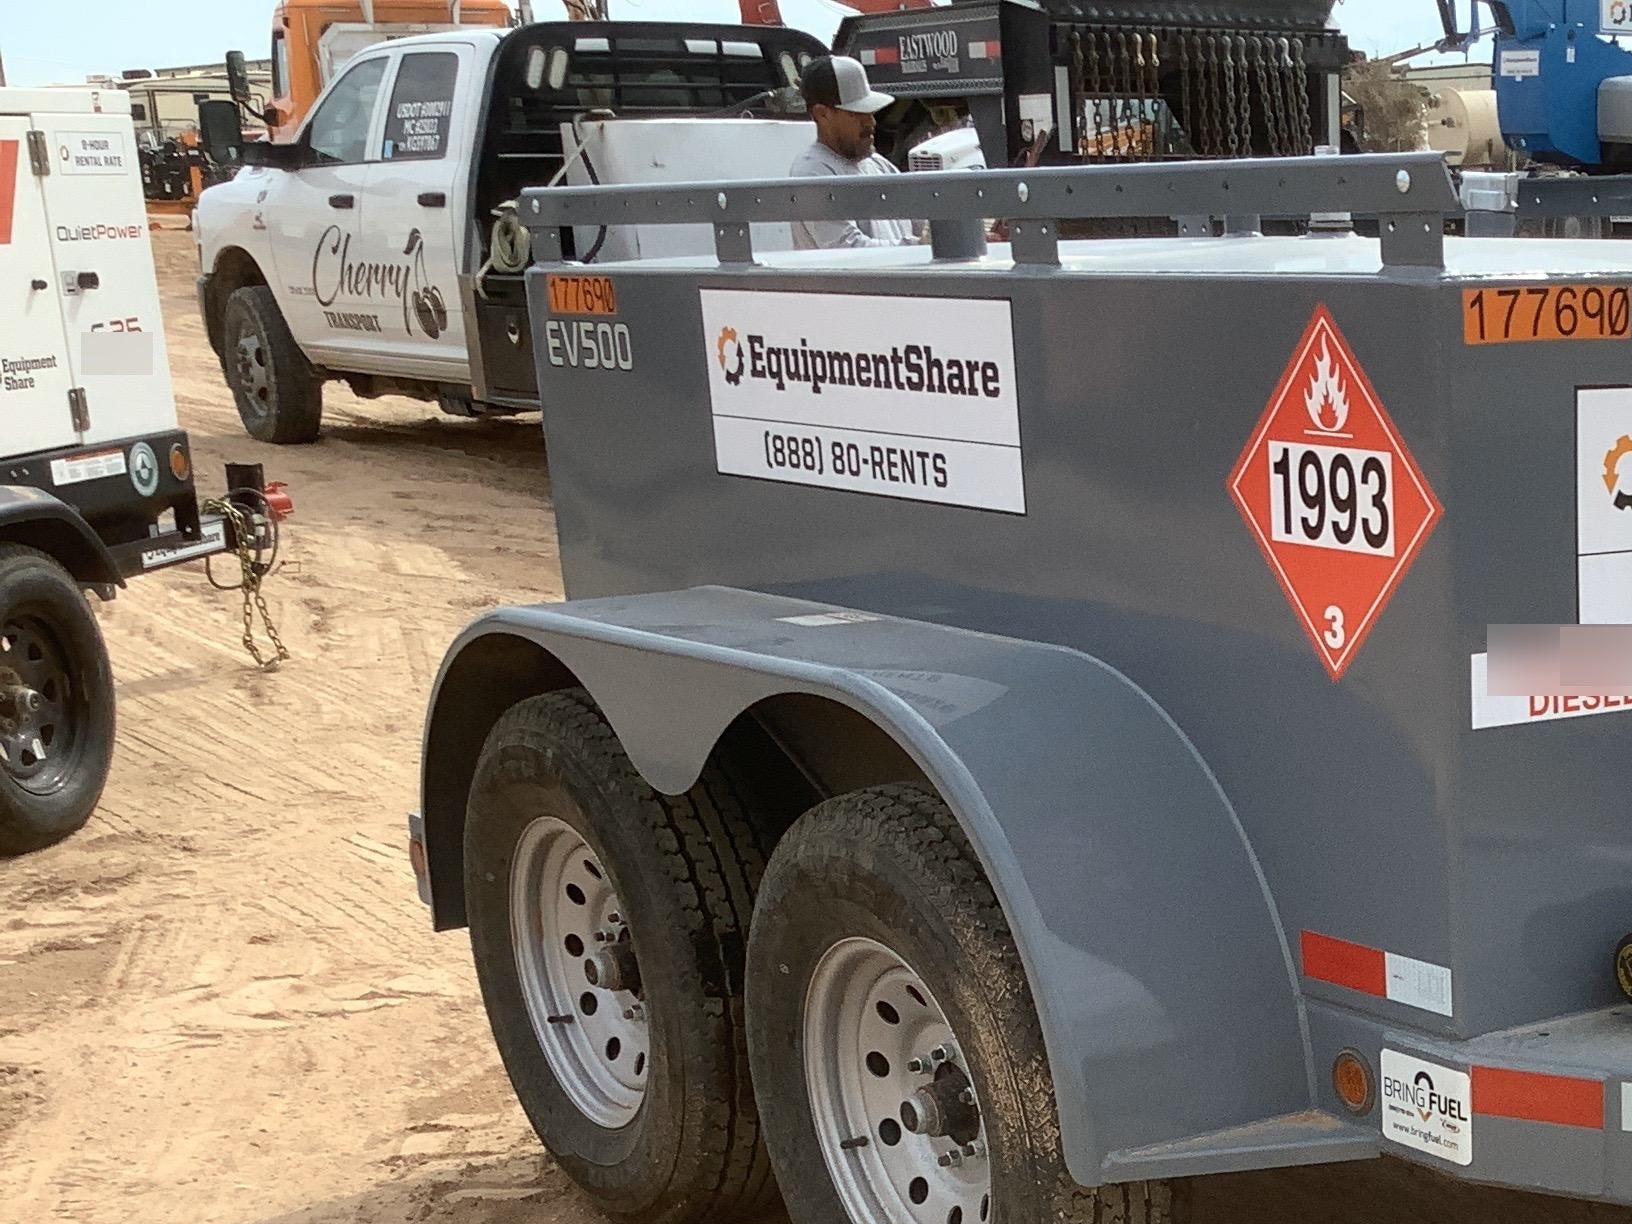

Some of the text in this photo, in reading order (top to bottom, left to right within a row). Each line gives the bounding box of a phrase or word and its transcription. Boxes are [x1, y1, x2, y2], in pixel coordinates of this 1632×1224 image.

[899, 30, 959, 60] EASTWOOD
[75, 156, 122, 167] RENTAL RATE
[81, 139, 110, 150] 8-HOUR
[56, 224, 142, 242] QuietPower
[313, 224, 413, 337] Cherry
[550, 277, 615, 313] 177690
[323, 310, 382, 333] TRANSPORT
[1470, 286, 1630, 341] 177690
[545, 320, 633, 370] EV500
[1, 354, 58, 376] Equipment
[747, 335, 1000, 398] EquipmentShare
[4, 376, 35, 391] Share
[764, 430, 948, 488] (888) 80-RENTS
[1272, 447, 1391, 550] 1993
[1323, 604, 1346, 650] 3
[1383, 1076, 1425, 1108] BRING
[1428, 1092, 1468, 1122] FUEL
[1392, 1121, 1459, 1151] www.bringfuel.com
